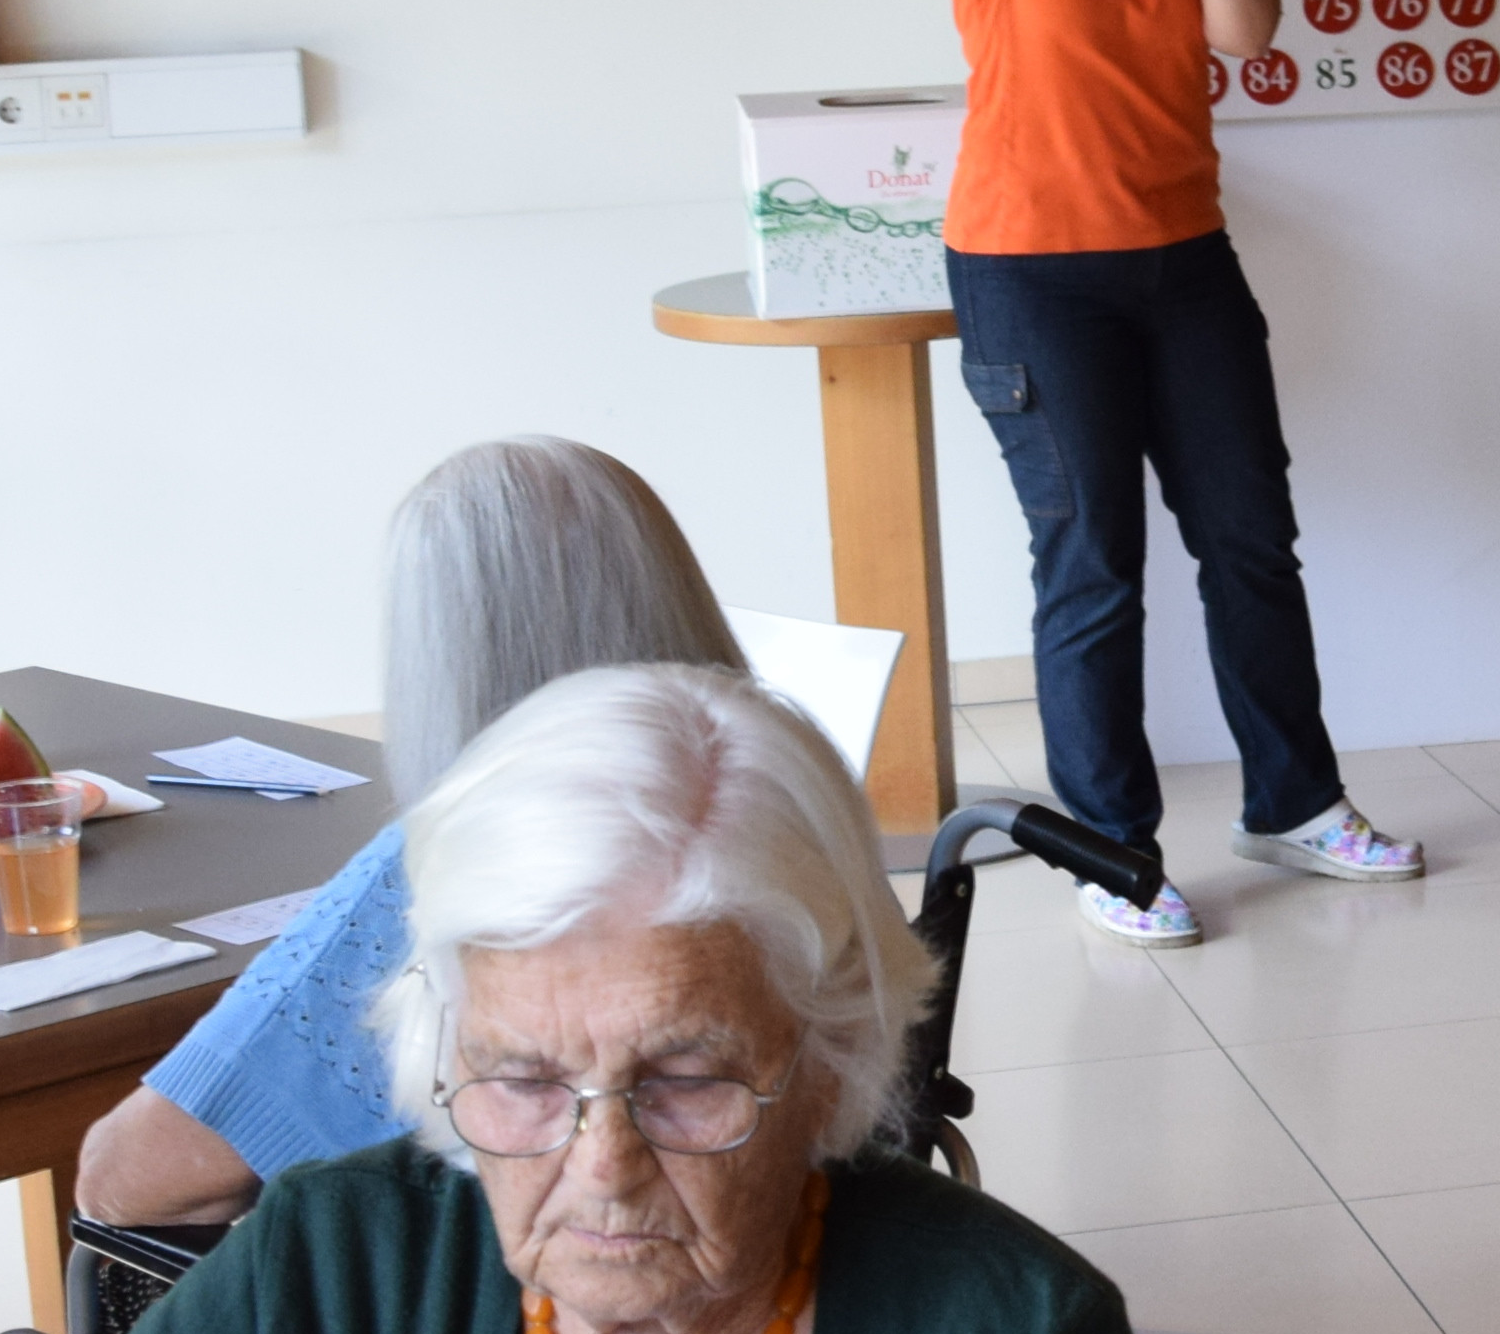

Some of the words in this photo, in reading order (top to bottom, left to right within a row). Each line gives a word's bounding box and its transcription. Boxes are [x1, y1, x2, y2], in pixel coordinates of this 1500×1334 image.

[1248, 61, 1291, 93] 84
[1316, 58, 1357, 89] 85
[1384, 55, 1428, 87] 86
[1452, 50, 1493, 84] 87
[867, 170, 932, 188] Donat
